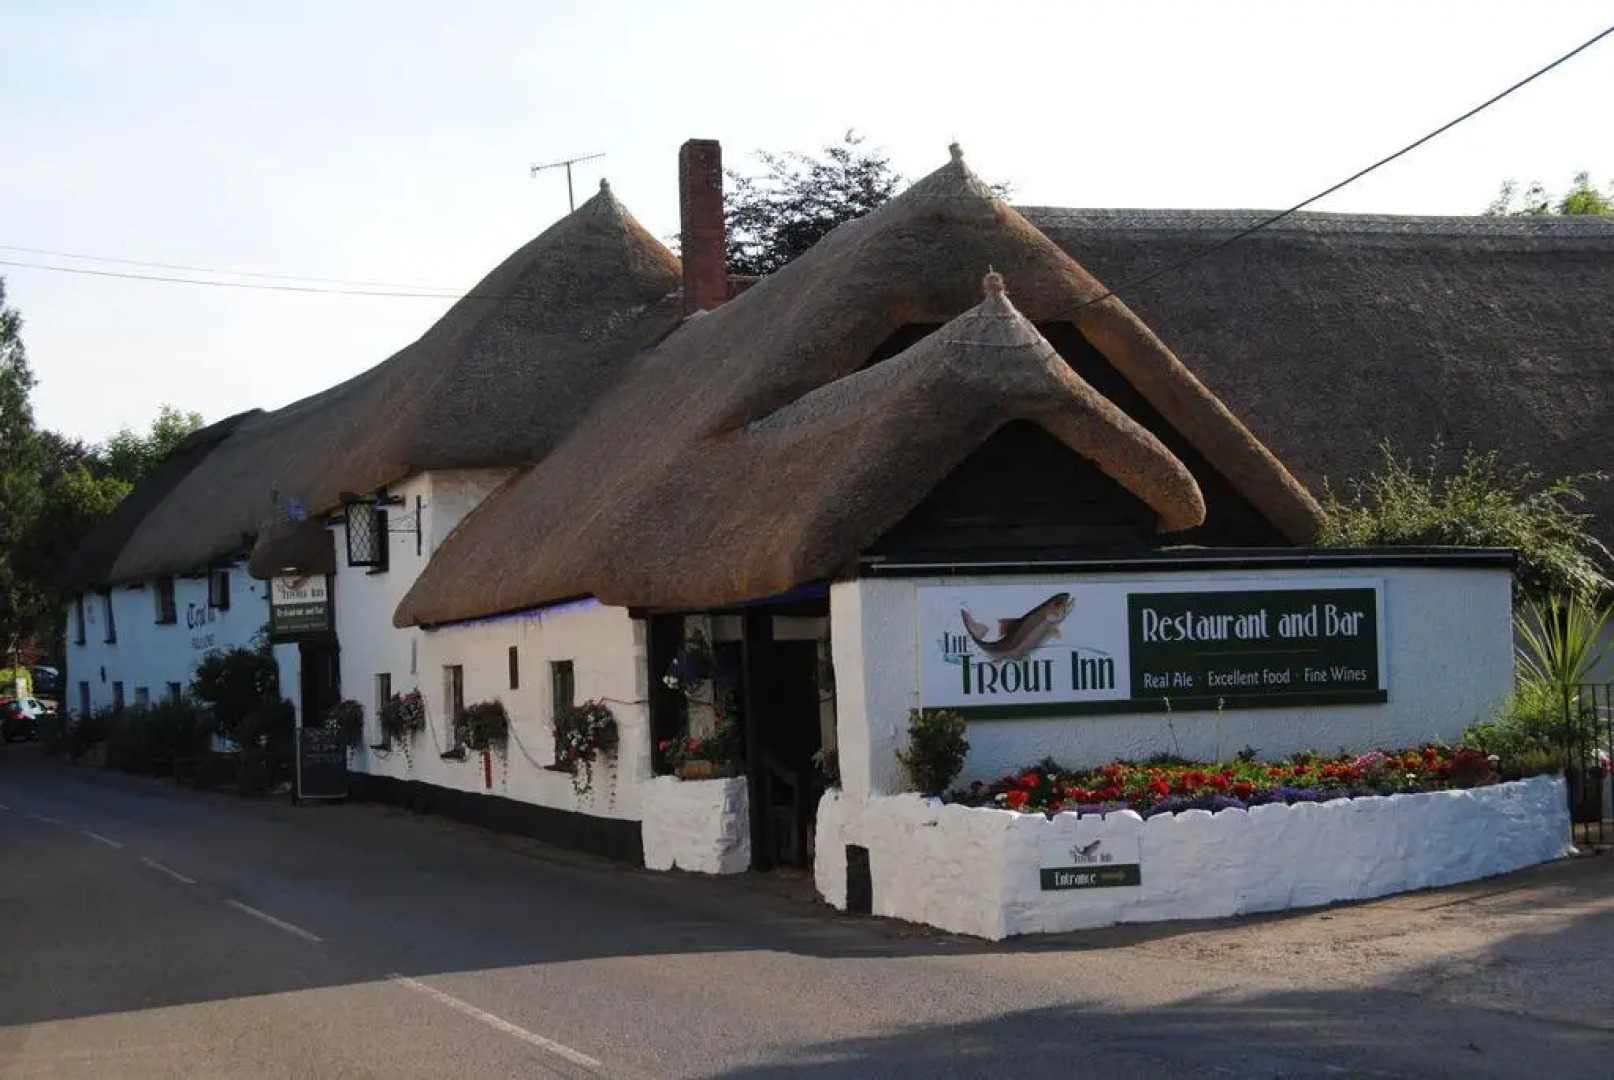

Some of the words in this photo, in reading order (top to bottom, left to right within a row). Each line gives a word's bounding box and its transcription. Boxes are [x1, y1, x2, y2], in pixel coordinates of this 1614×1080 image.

[1142, 607, 1271, 643] Restaurant
[1277, 604, 1318, 638] and
[1325, 603, 1366, 636] Bar
[1071, 650, 1115, 690] Inn
[1143, 671, 1169, 689] Real
[1172, 671, 1194, 688] Ale
[1208, 668, 1259, 687] Excellent
[1263, 668, 1290, 685] Food
[1304, 667, 1328, 683] Fine
[1330, 665, 1368, 682] Wines
